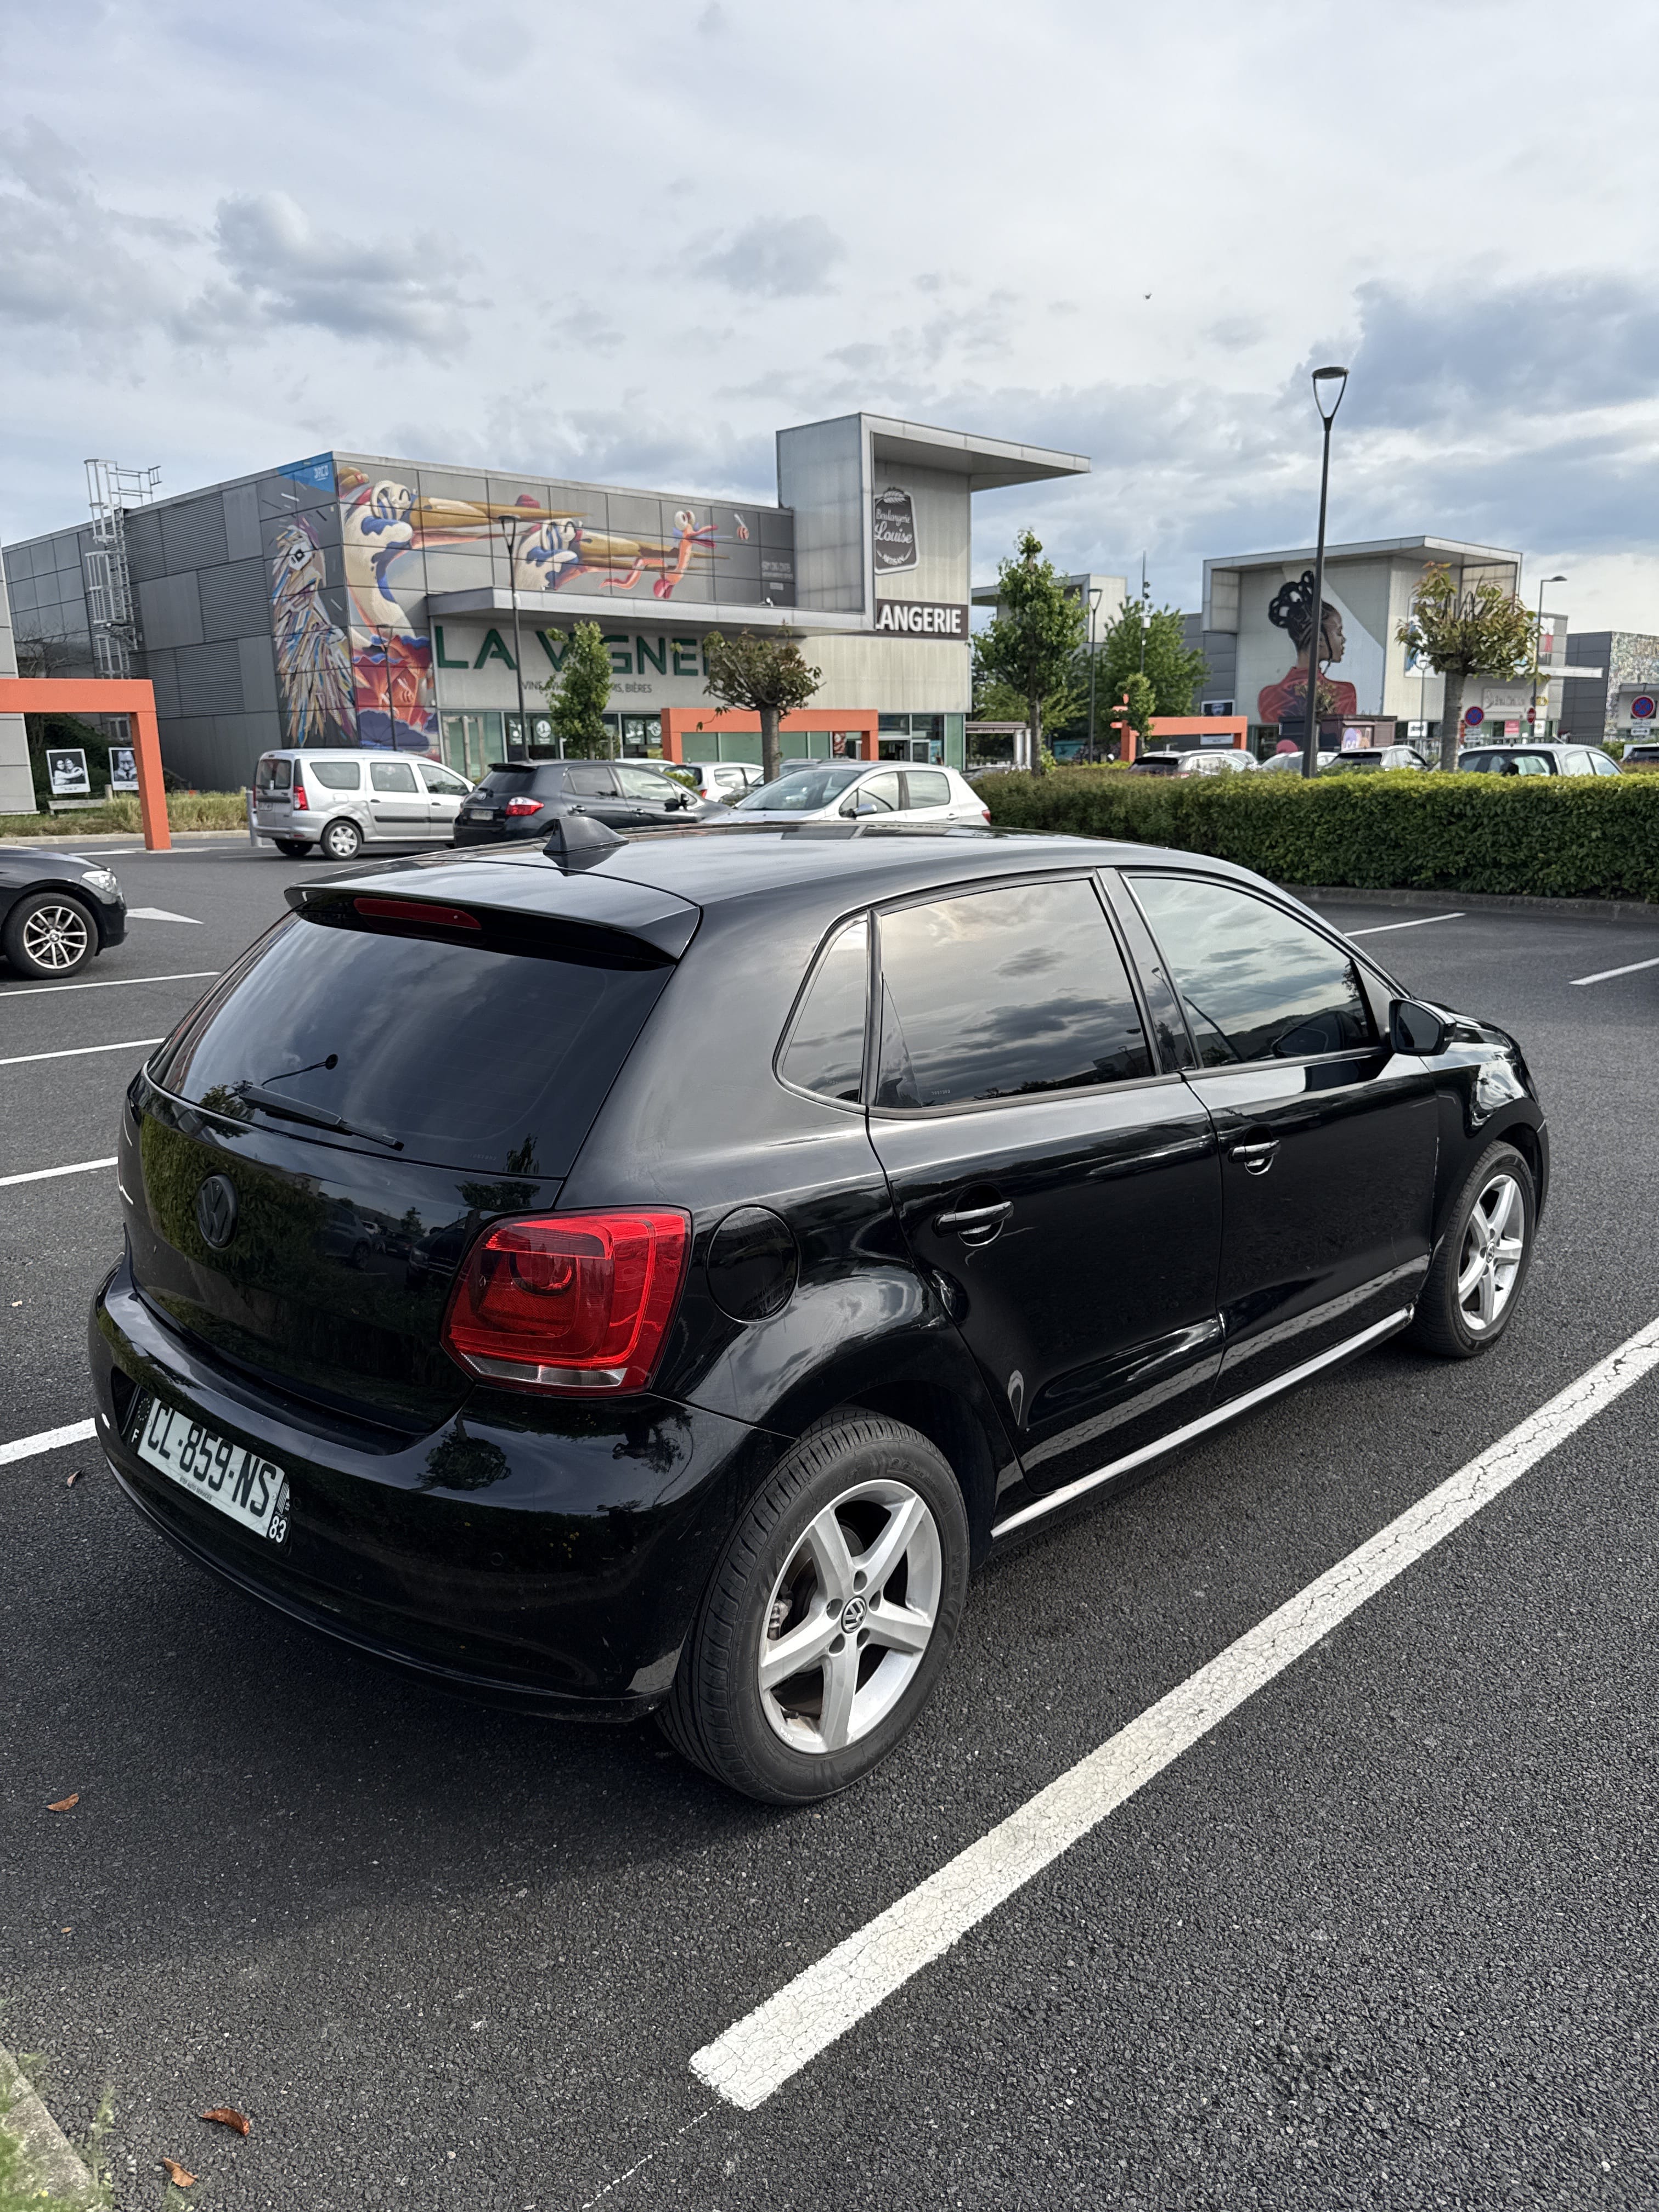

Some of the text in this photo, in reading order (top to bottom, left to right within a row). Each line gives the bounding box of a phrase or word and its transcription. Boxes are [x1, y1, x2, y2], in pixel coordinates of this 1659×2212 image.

[874, 521, 913, 544] Louise
[435, 625, 518, 670] LA
[625, 682, 653, 693] BIÈRES
[131, 1428, 139, 1443] F
[148, 1401, 276, 1518] CL-859-NS
[269, 1515, 287, 1543] 83
